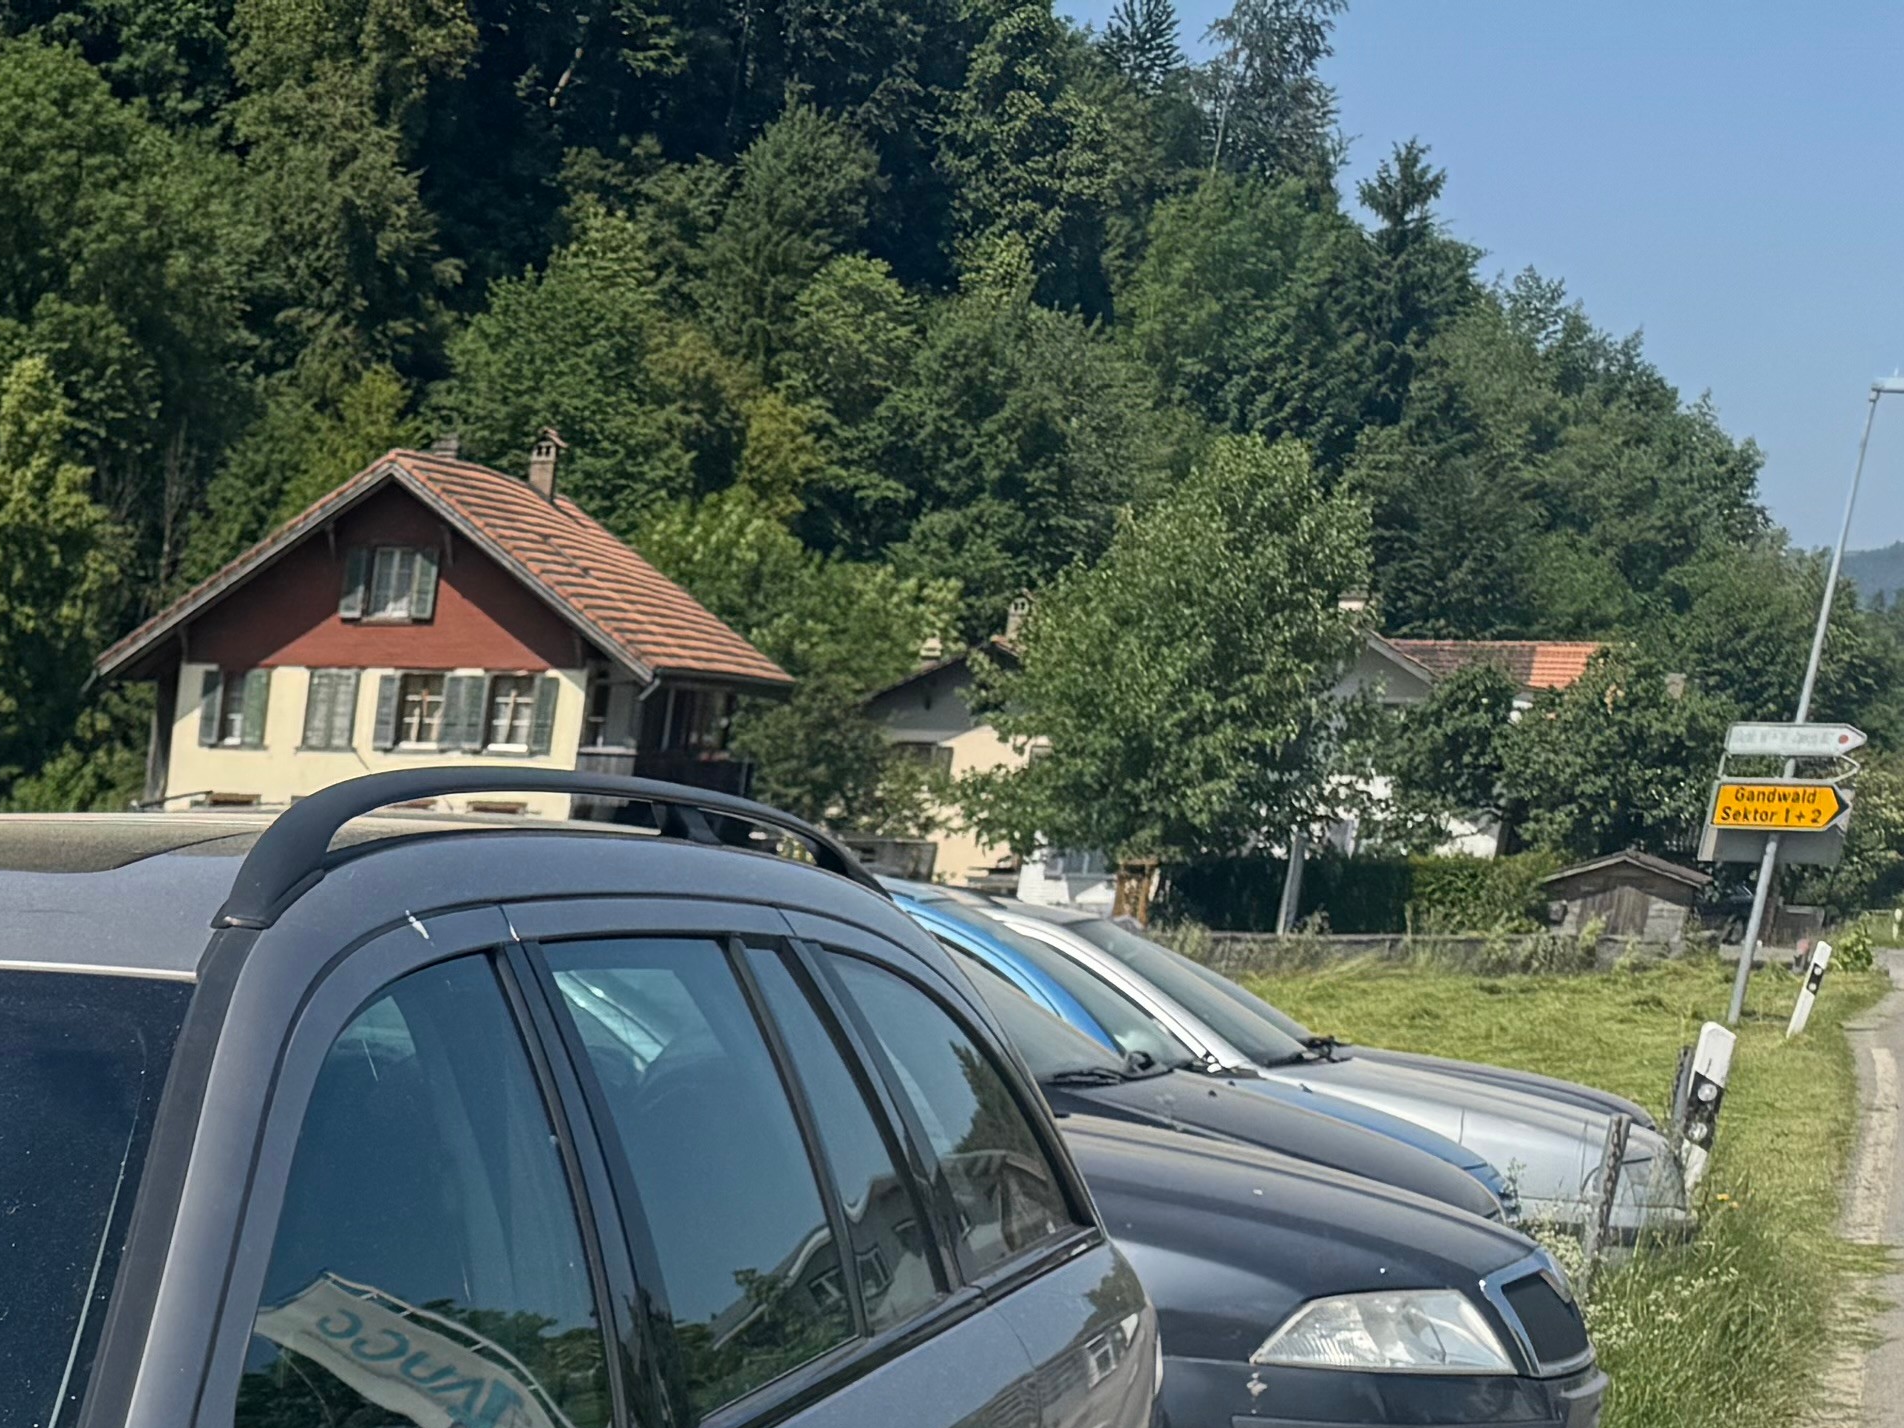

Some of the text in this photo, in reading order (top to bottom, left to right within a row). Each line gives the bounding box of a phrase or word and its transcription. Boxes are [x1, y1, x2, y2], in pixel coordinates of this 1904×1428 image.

[1734, 786, 1818, 804] Gandwald
[1720, 805, 1778, 823] Sektor
[1794, 810, 1805, 823] +
[1811, 808, 1823, 824] 2
